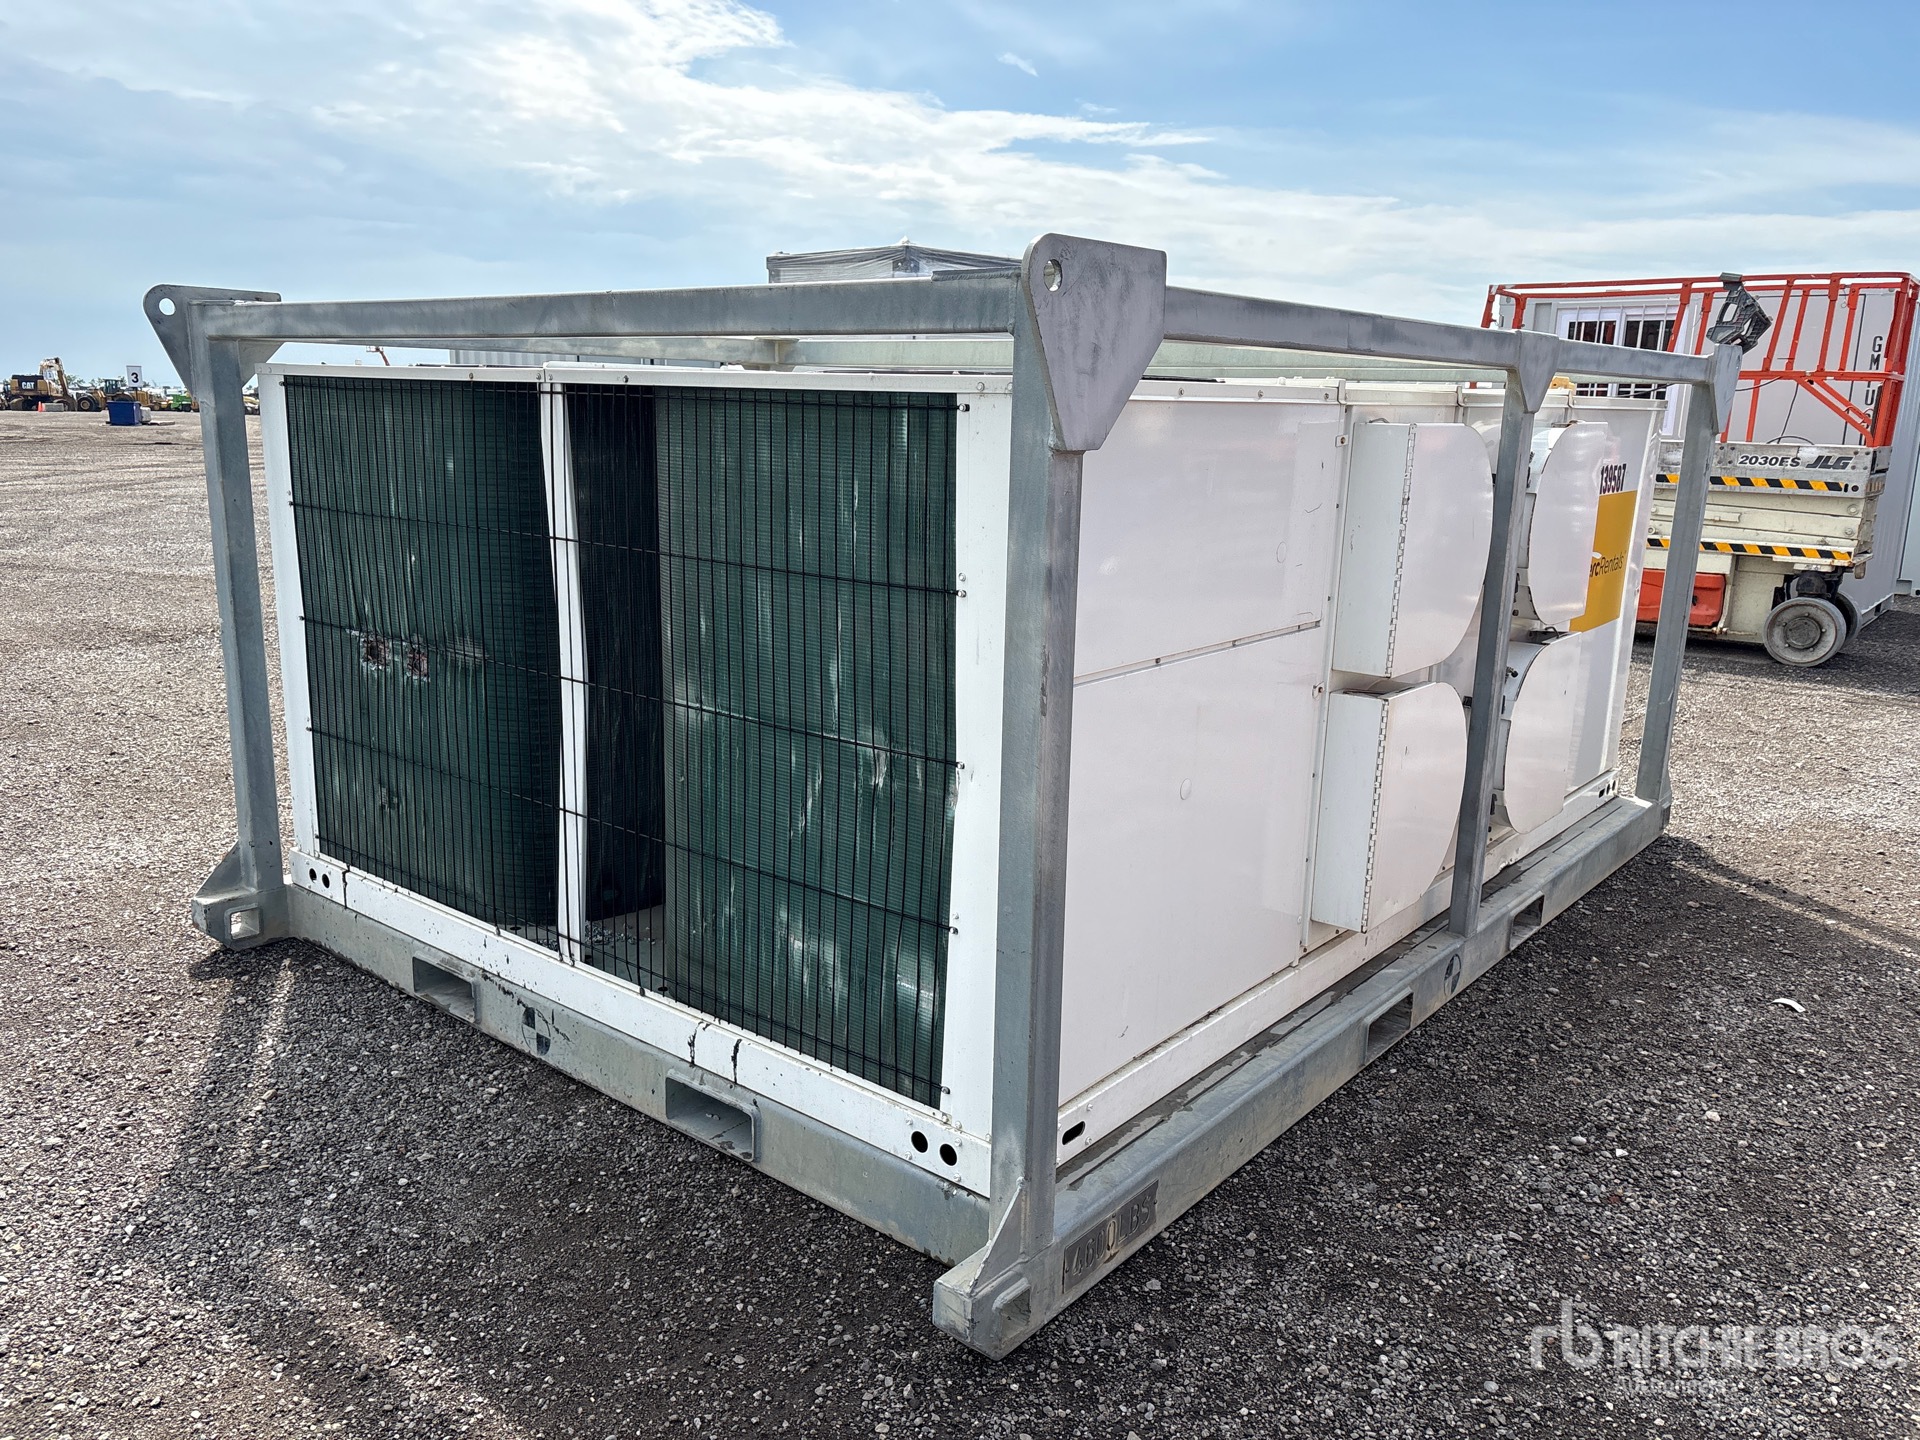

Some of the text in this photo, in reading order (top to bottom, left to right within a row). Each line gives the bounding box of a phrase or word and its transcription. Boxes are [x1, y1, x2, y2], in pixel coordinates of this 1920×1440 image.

[131, 372, 139, 384] 3
[21, 381, 35, 390] CAT
[1738, 455, 1853, 469] 2030ES JLG
[1600, 463, 1627, 495] 139587
[1072, 1195, 1152, 1275] 4600 LBS
